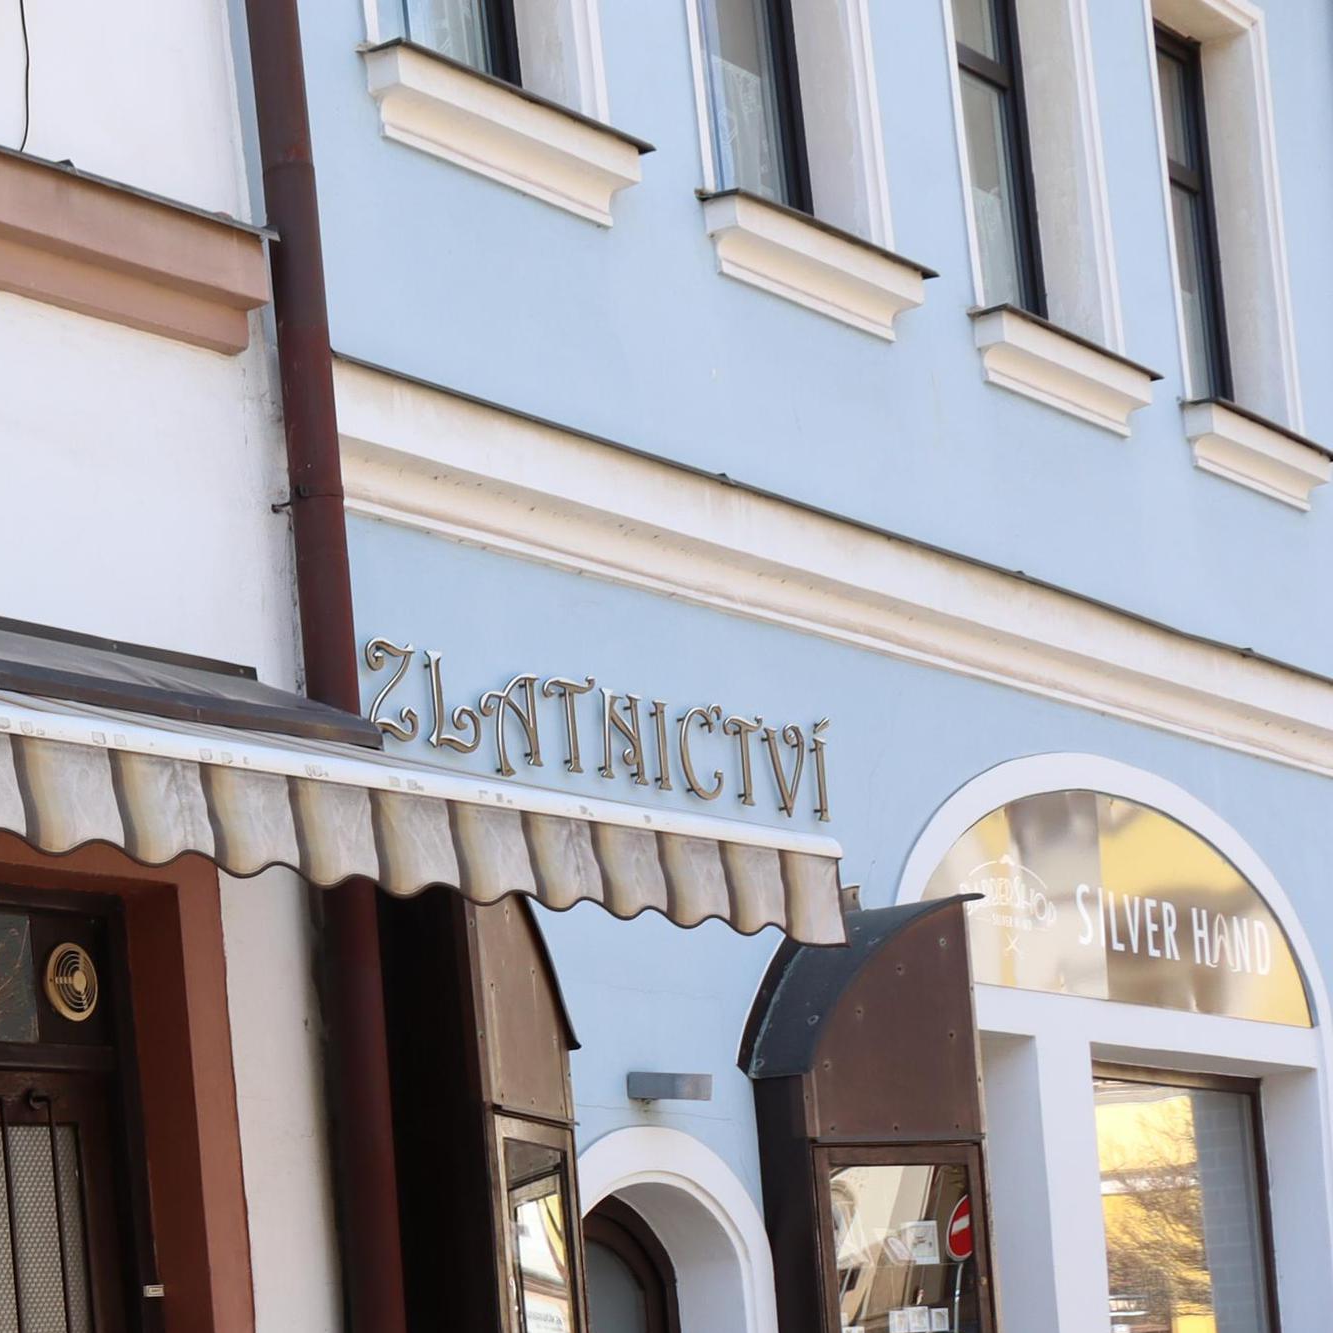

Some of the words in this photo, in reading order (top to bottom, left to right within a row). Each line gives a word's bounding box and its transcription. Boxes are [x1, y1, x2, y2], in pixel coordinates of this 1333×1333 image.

[365, 637, 831, 823] ZLATNICTVÍ
[1075, 883, 1181, 961] SILVER
[1190, 907, 1273, 977] HAND
